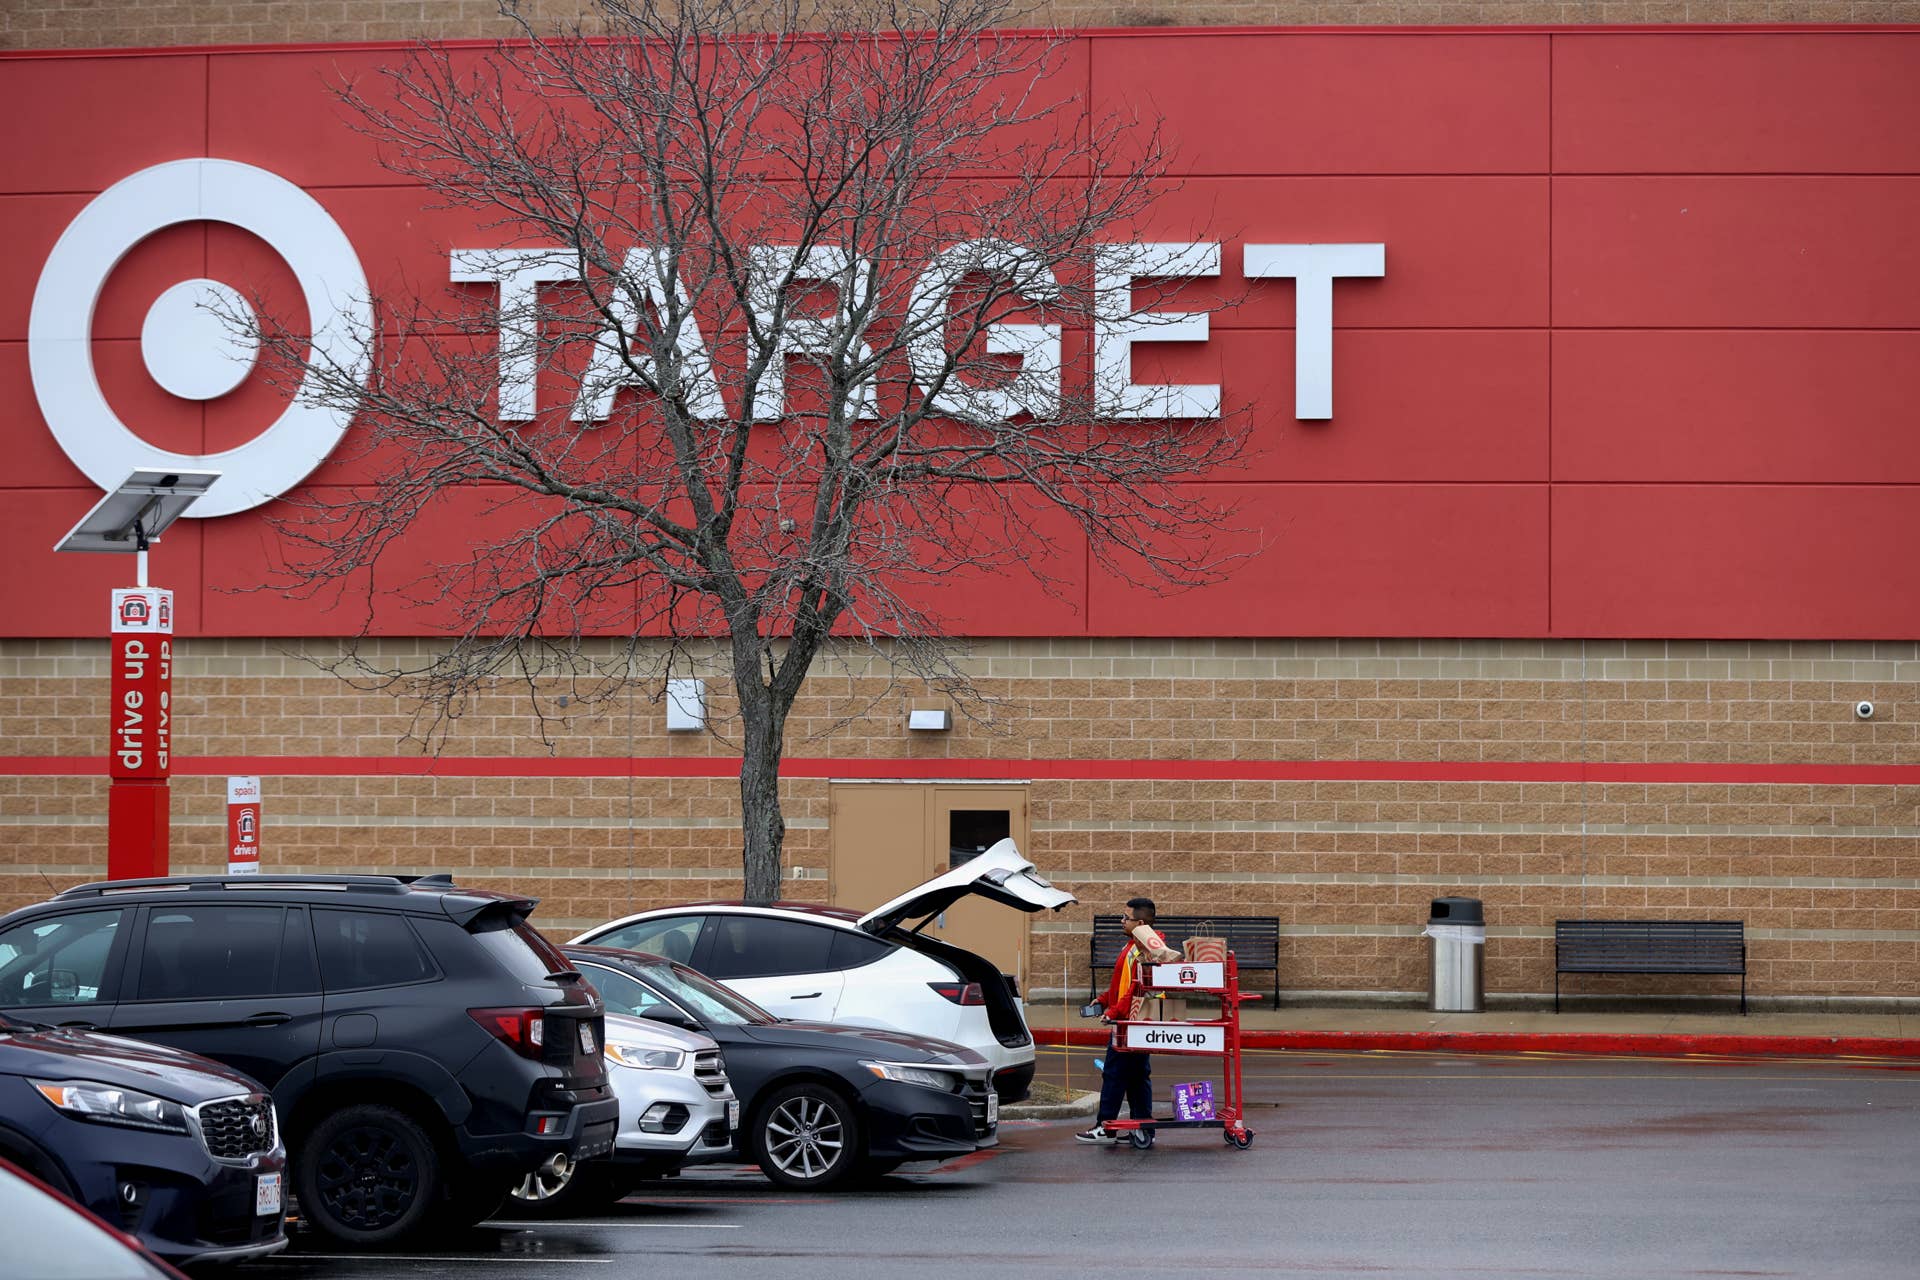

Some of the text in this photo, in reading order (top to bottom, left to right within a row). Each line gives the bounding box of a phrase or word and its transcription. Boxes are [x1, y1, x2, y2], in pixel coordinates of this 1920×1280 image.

[450, 238, 1386, 421] TARGET
[117, 640, 149, 769] drive up
[157, 640, 171, 769] drive up
[233, 844, 252, 855] drive
[1145, 1030, 1206, 1047] drive up
